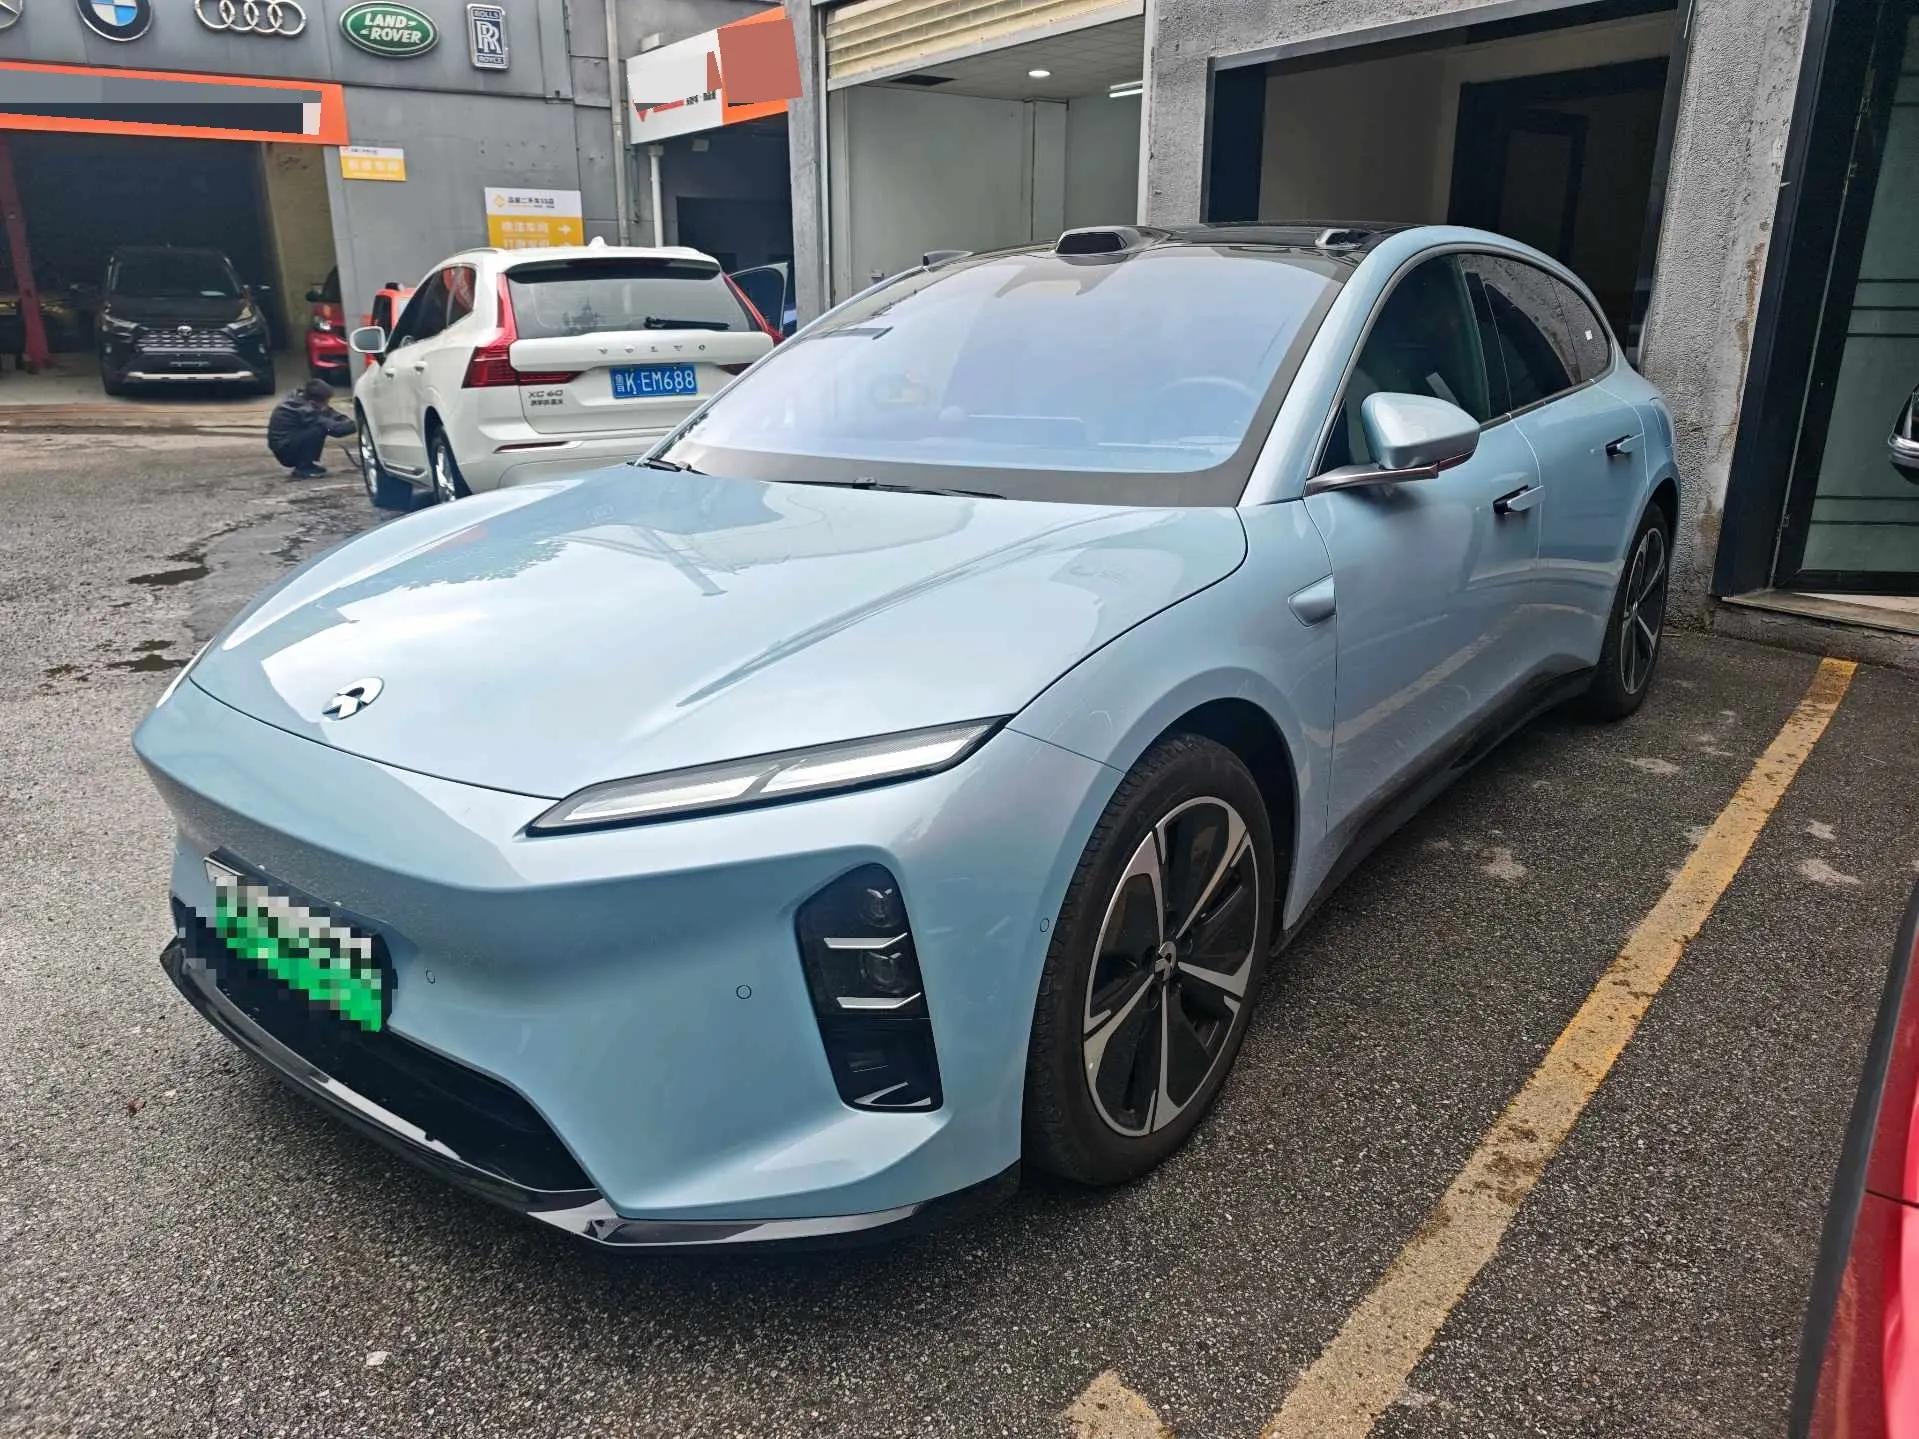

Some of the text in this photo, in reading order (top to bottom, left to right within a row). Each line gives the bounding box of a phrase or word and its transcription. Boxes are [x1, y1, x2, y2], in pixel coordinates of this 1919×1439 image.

[364, 13, 407, 28] LAND
[370, 27, 422, 44] ROVER
[477, 56, 504, 64] ROYCE
[598, 344, 707, 354] VOLVO
